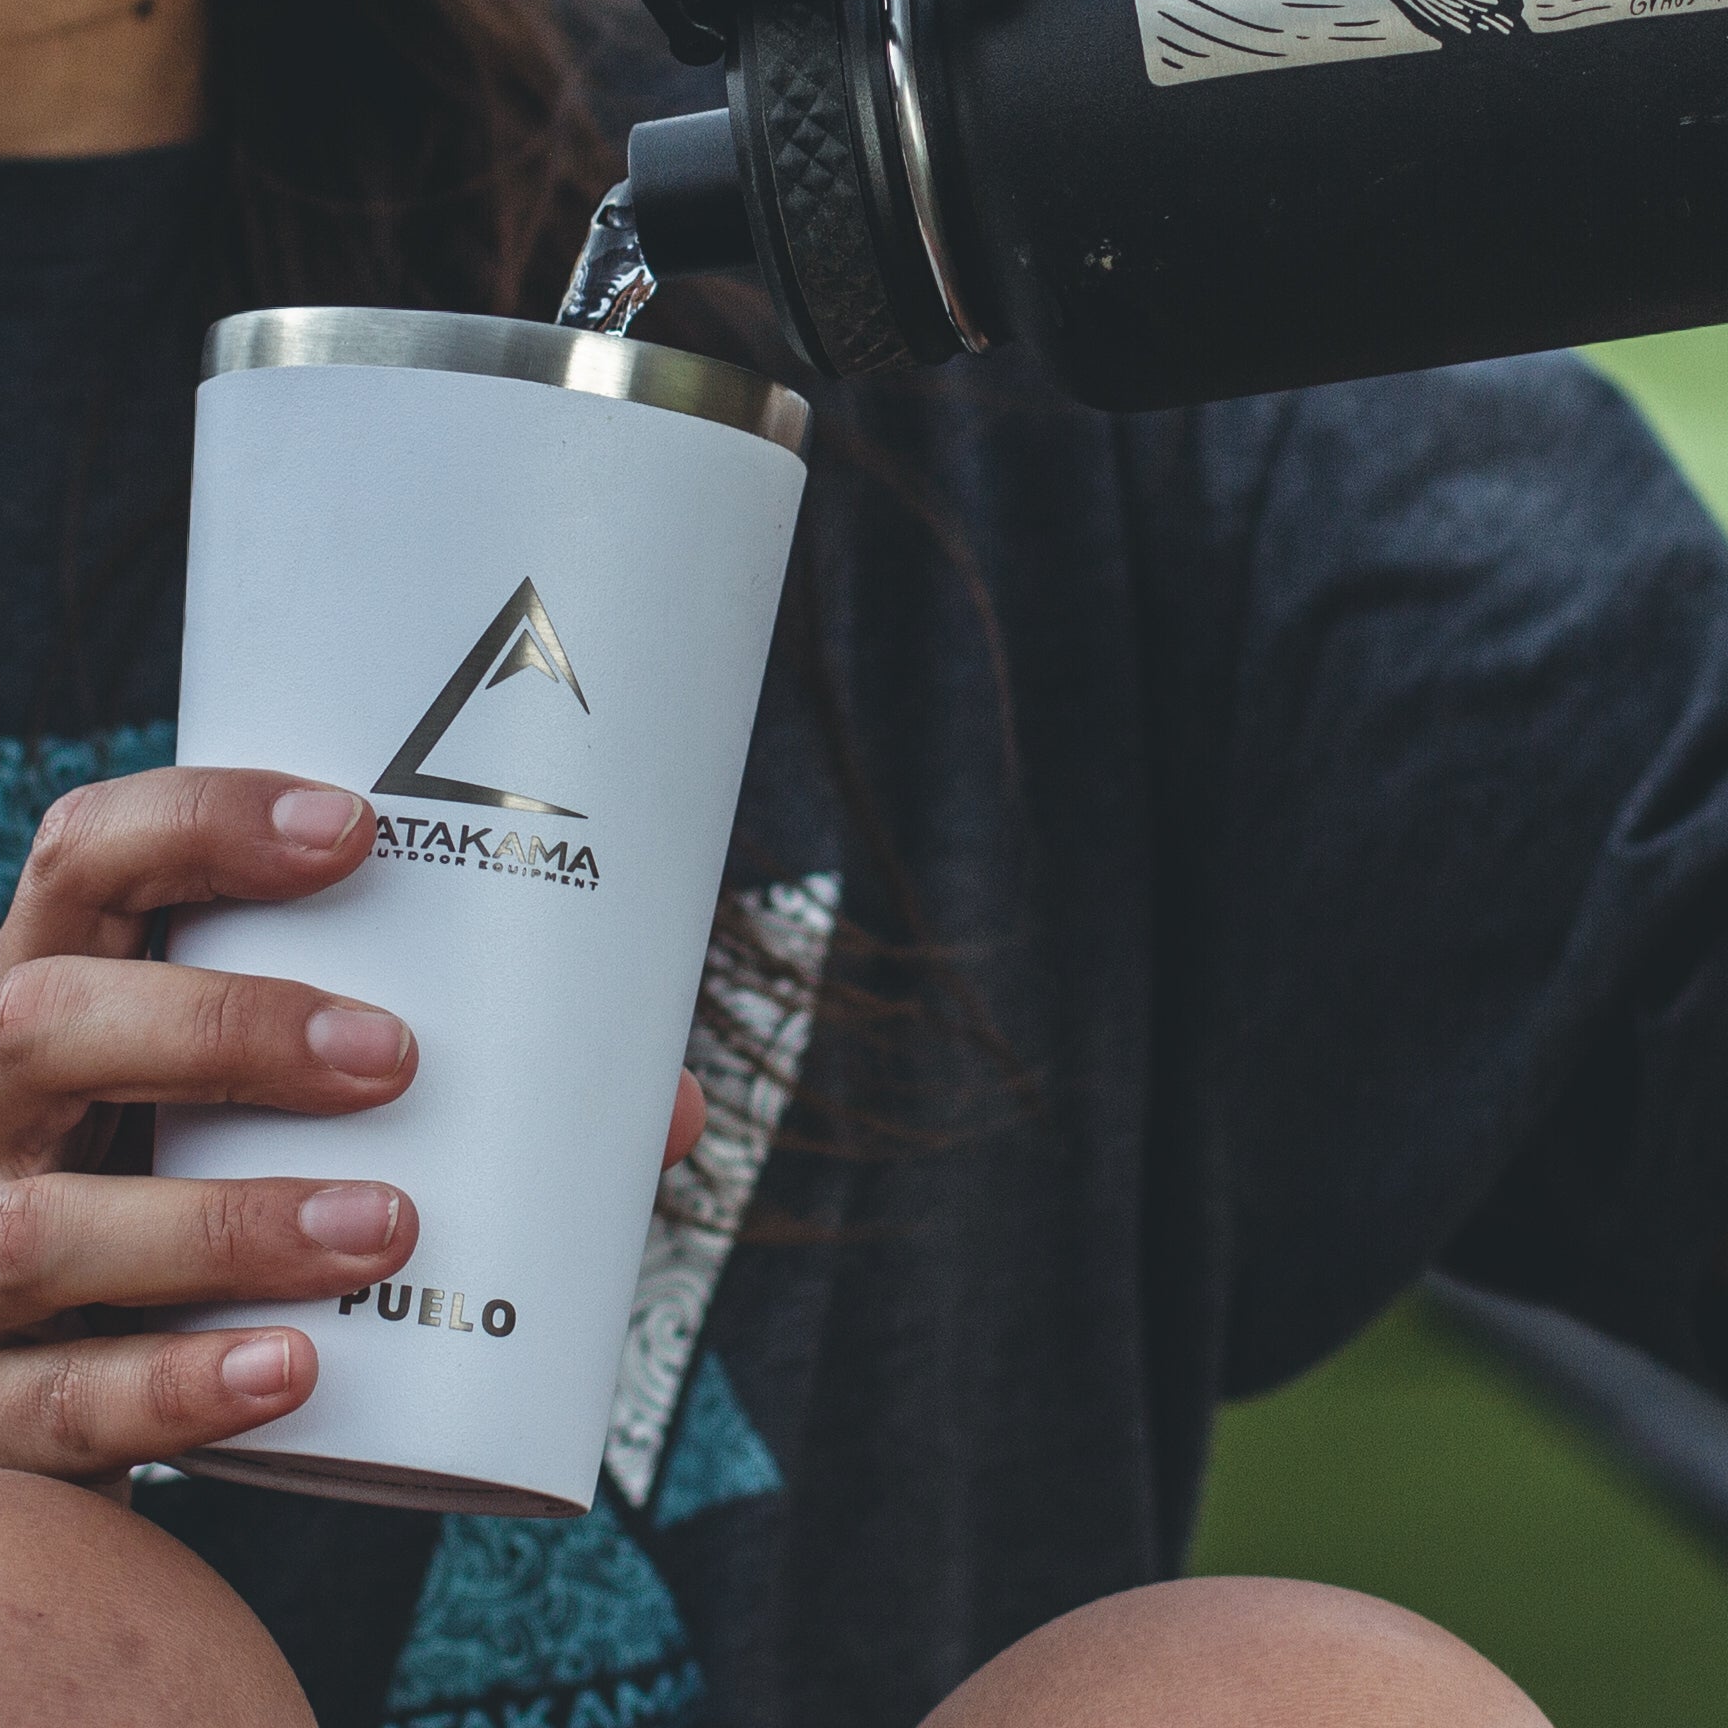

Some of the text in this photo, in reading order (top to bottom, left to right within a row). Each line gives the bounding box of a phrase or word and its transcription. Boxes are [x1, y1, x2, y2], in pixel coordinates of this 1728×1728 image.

[368, 848, 599, 891] UTDOOR EQUIPMENT
[376, 815, 600, 879] ATAKAMA
[338, 1282, 517, 1338] PUELO
